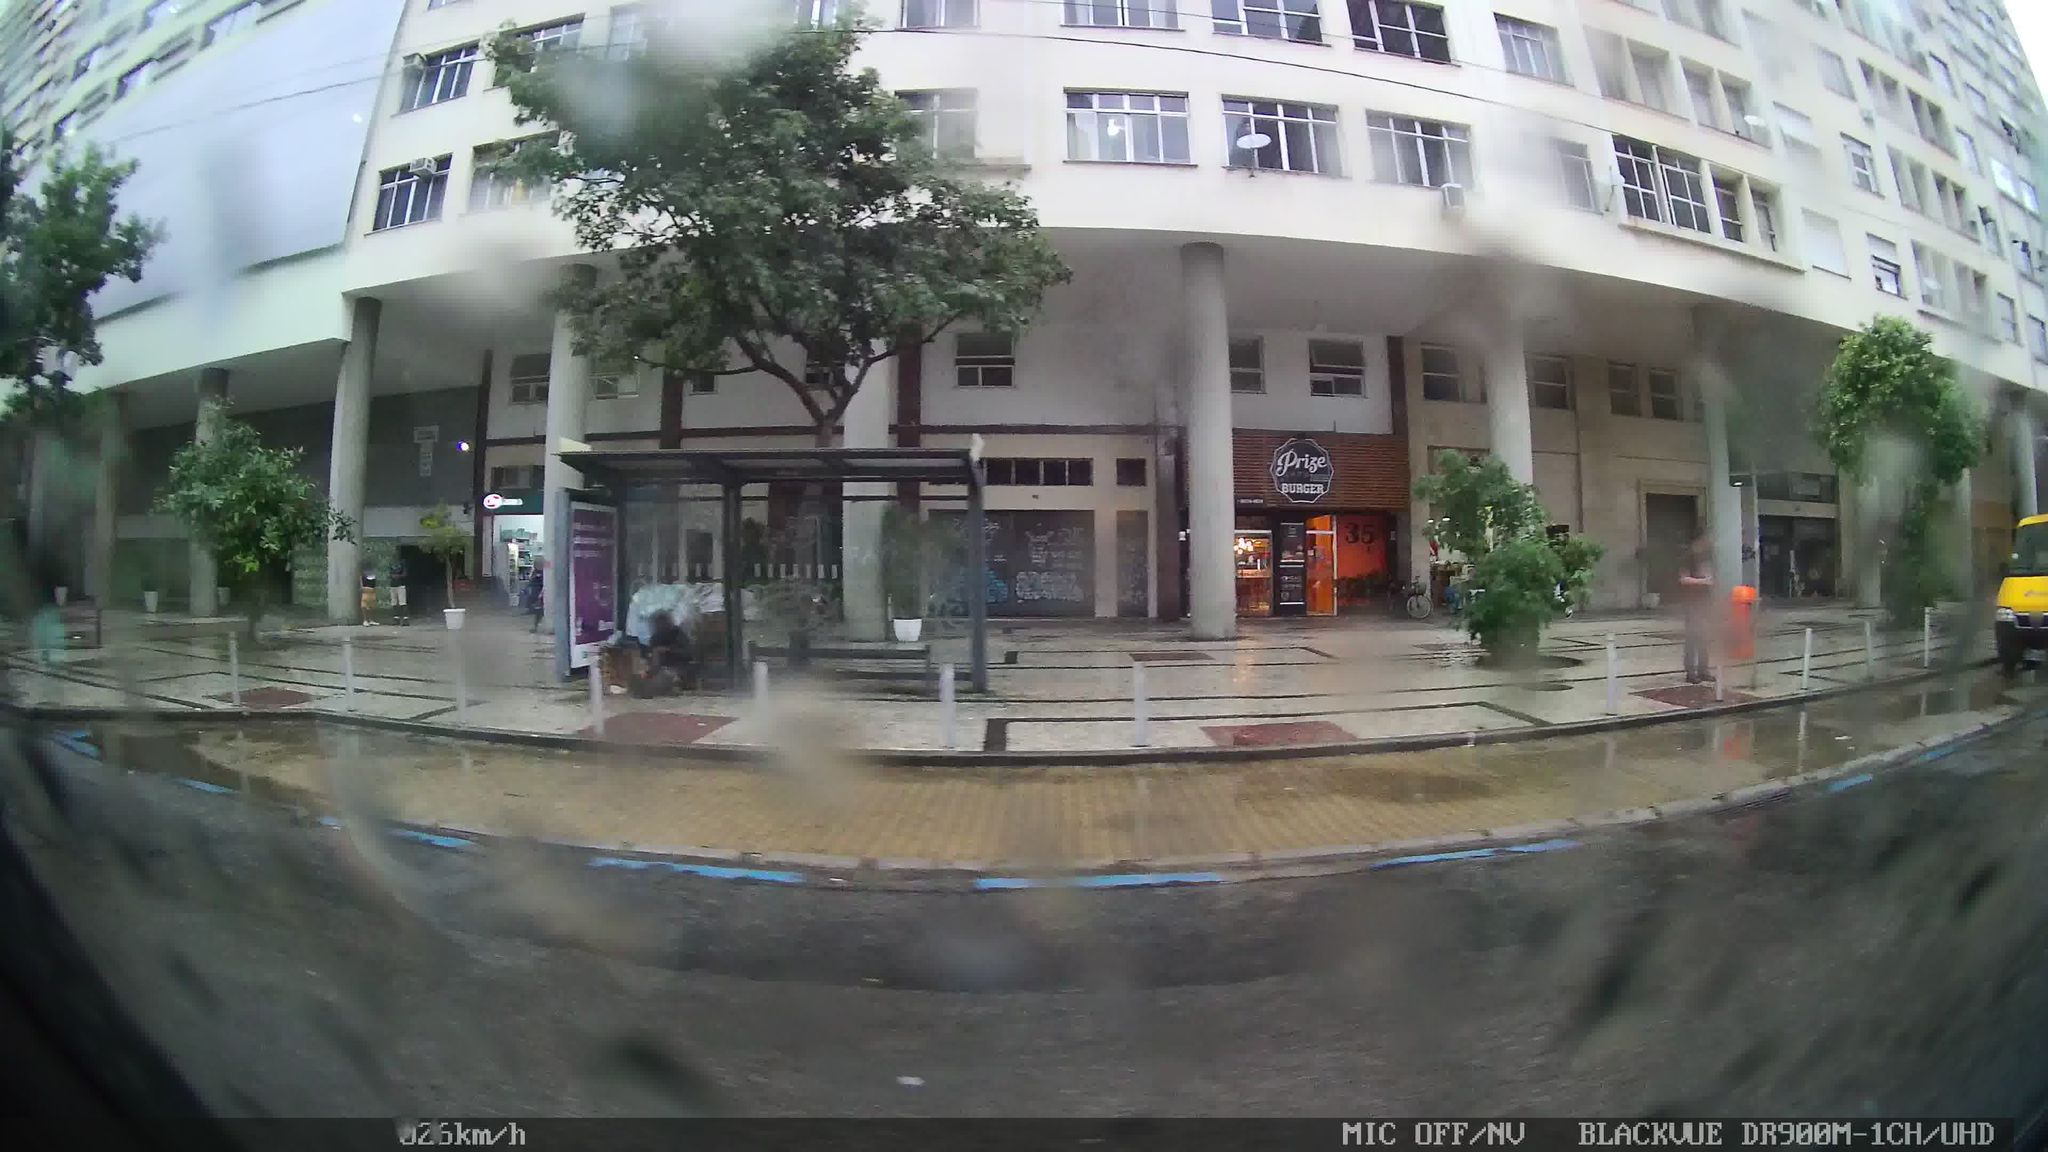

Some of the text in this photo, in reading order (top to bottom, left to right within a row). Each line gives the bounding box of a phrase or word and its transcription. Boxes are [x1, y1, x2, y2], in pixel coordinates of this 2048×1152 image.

[1275, 449, 1328, 477] Prize
[1281, 482, 1324, 494] BURGER
[1344, 522, 1376, 545] 35
